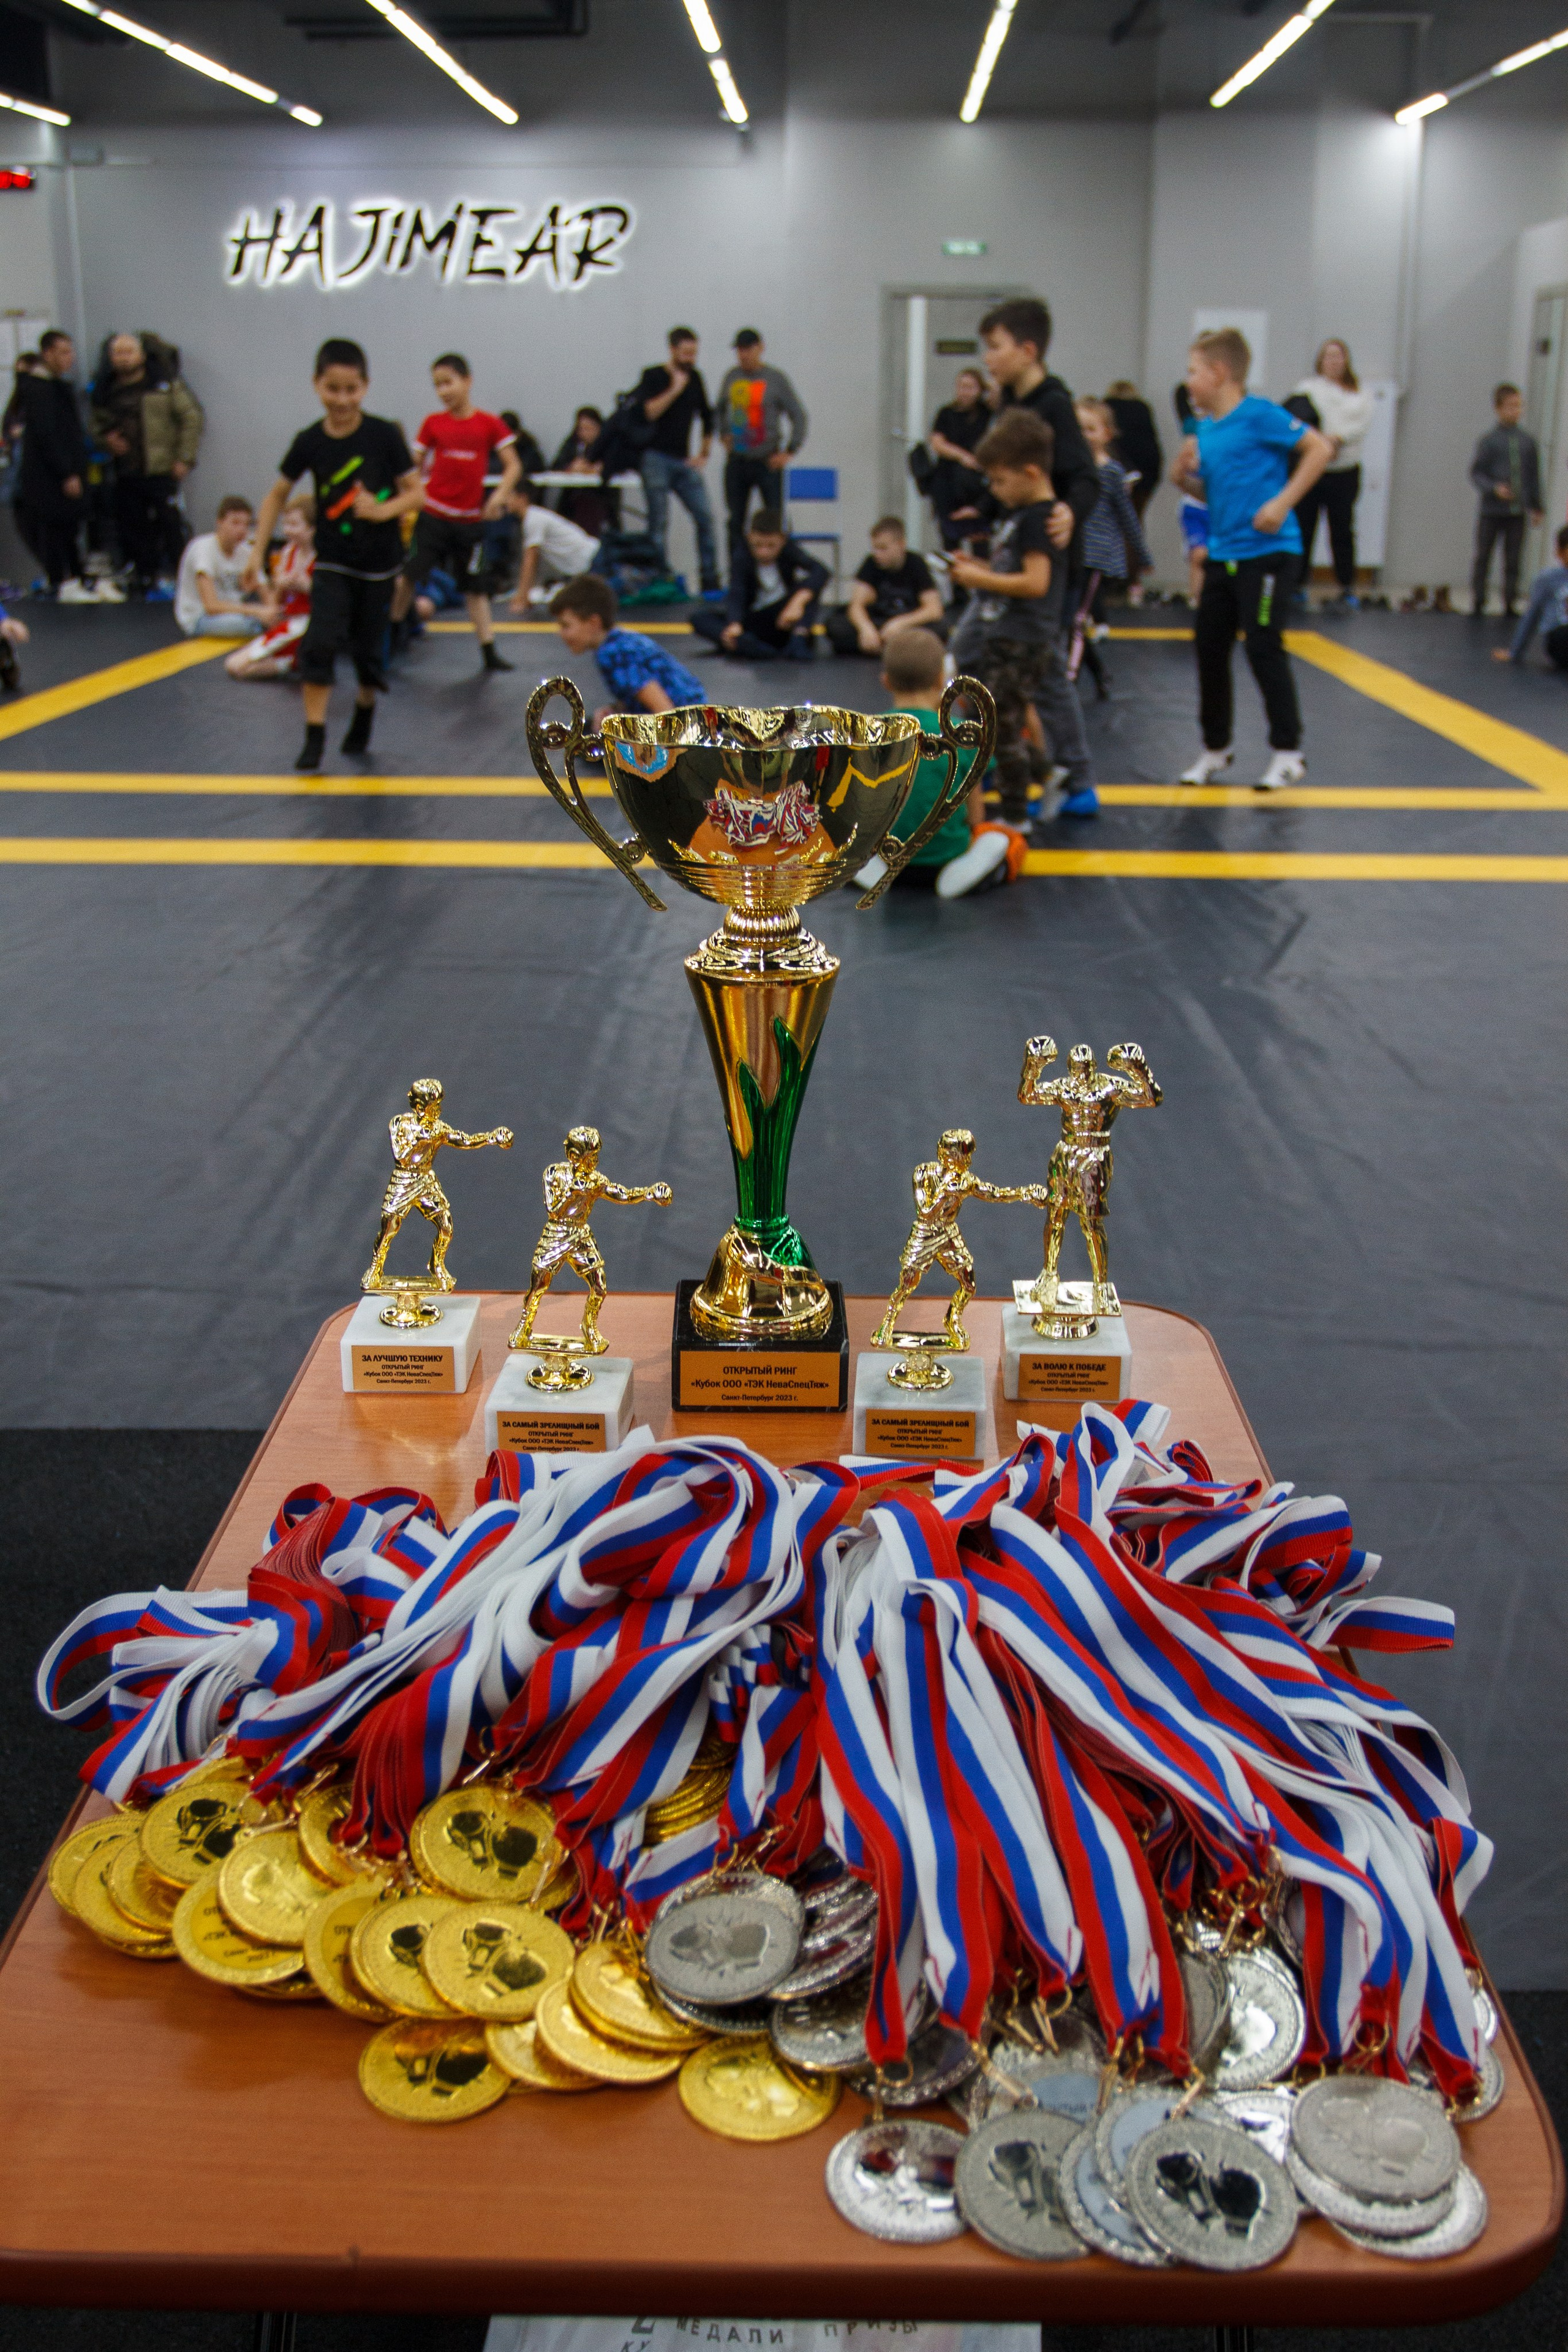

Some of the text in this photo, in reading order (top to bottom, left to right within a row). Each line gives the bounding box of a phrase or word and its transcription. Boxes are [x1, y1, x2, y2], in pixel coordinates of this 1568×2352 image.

[228, 201, 631, 284] HAJIMEAR
[723, 1366, 772, 1375] ОТКРЫТЫЙ
[1076, 1363, 1106, 1372] ПОБЕДЕ
[691, 1379, 721, 1390] «Кубок
[744, 1380, 764, 1389] «ТЭК
